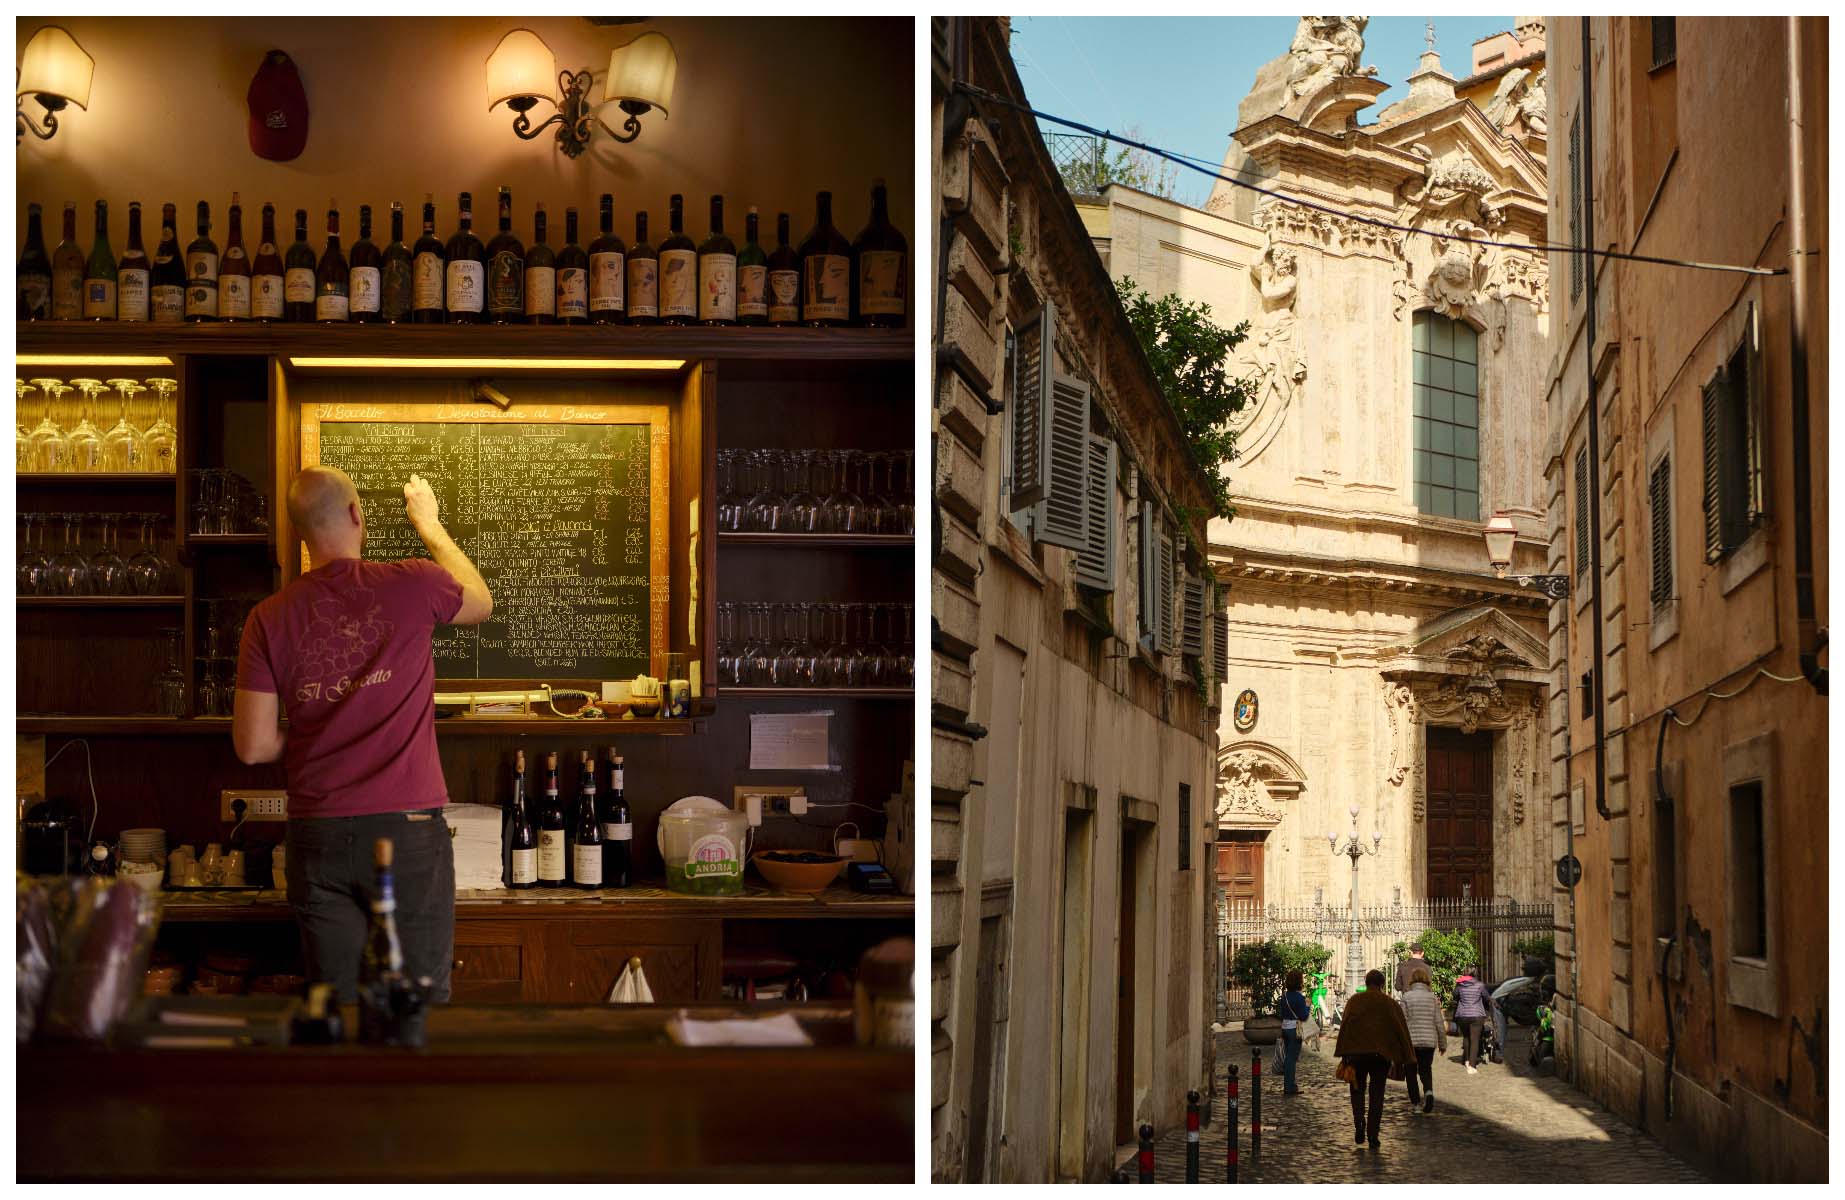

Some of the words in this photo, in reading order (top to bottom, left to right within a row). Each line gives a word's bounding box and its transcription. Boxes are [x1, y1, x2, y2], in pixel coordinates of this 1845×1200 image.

[559, 406, 608, 420] Banco
[508, 558, 539, 568] CHINATO
[696, 863, 731, 873] ANDRIA
